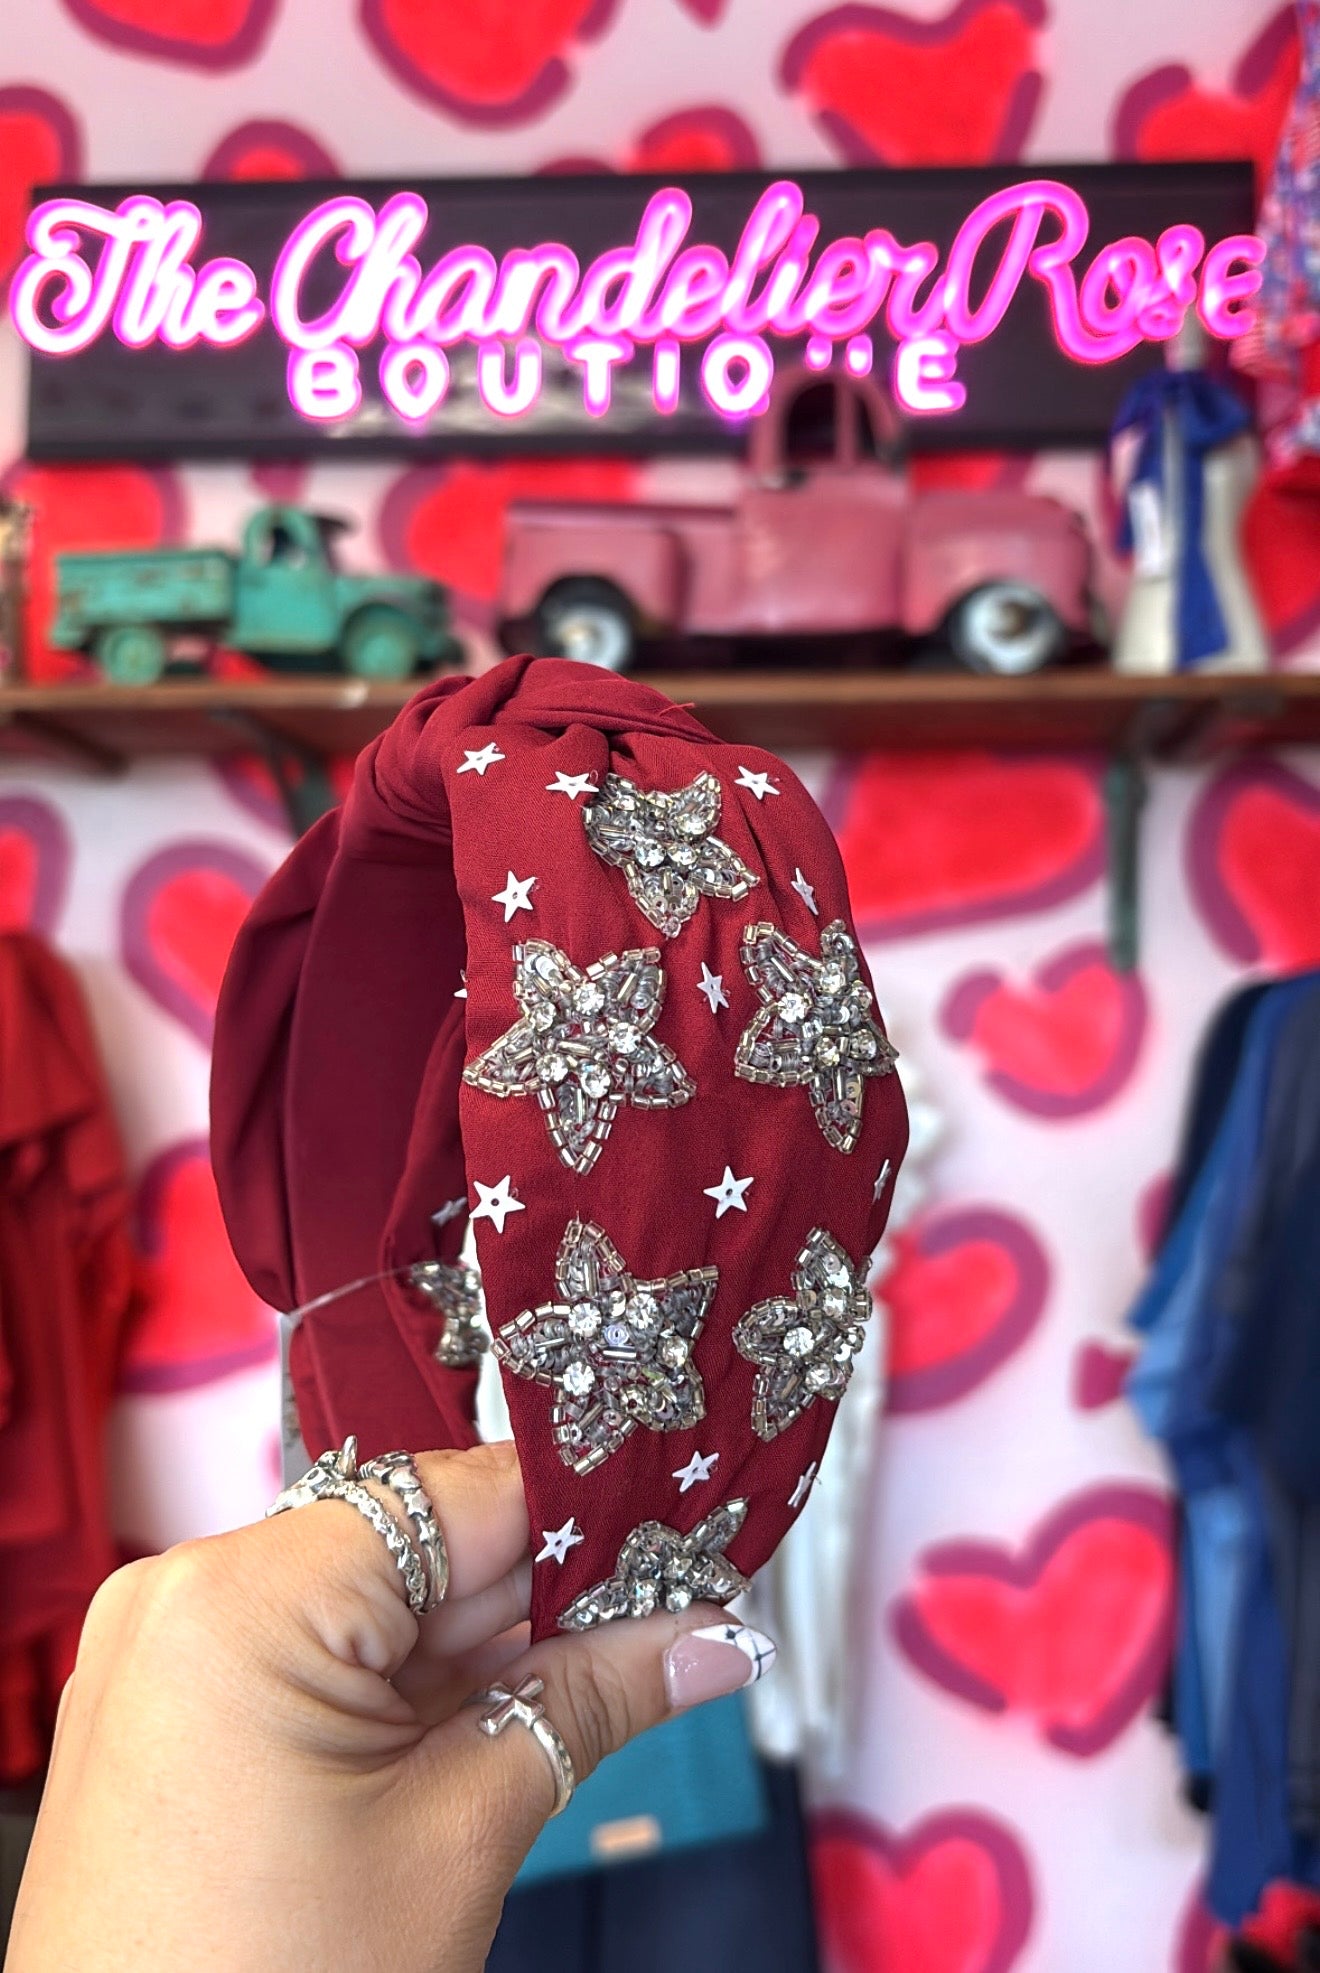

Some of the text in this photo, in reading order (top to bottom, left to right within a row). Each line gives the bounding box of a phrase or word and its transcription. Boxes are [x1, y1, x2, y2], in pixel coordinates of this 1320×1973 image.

[11, 180, 1267, 365] The Chandelier Rose
